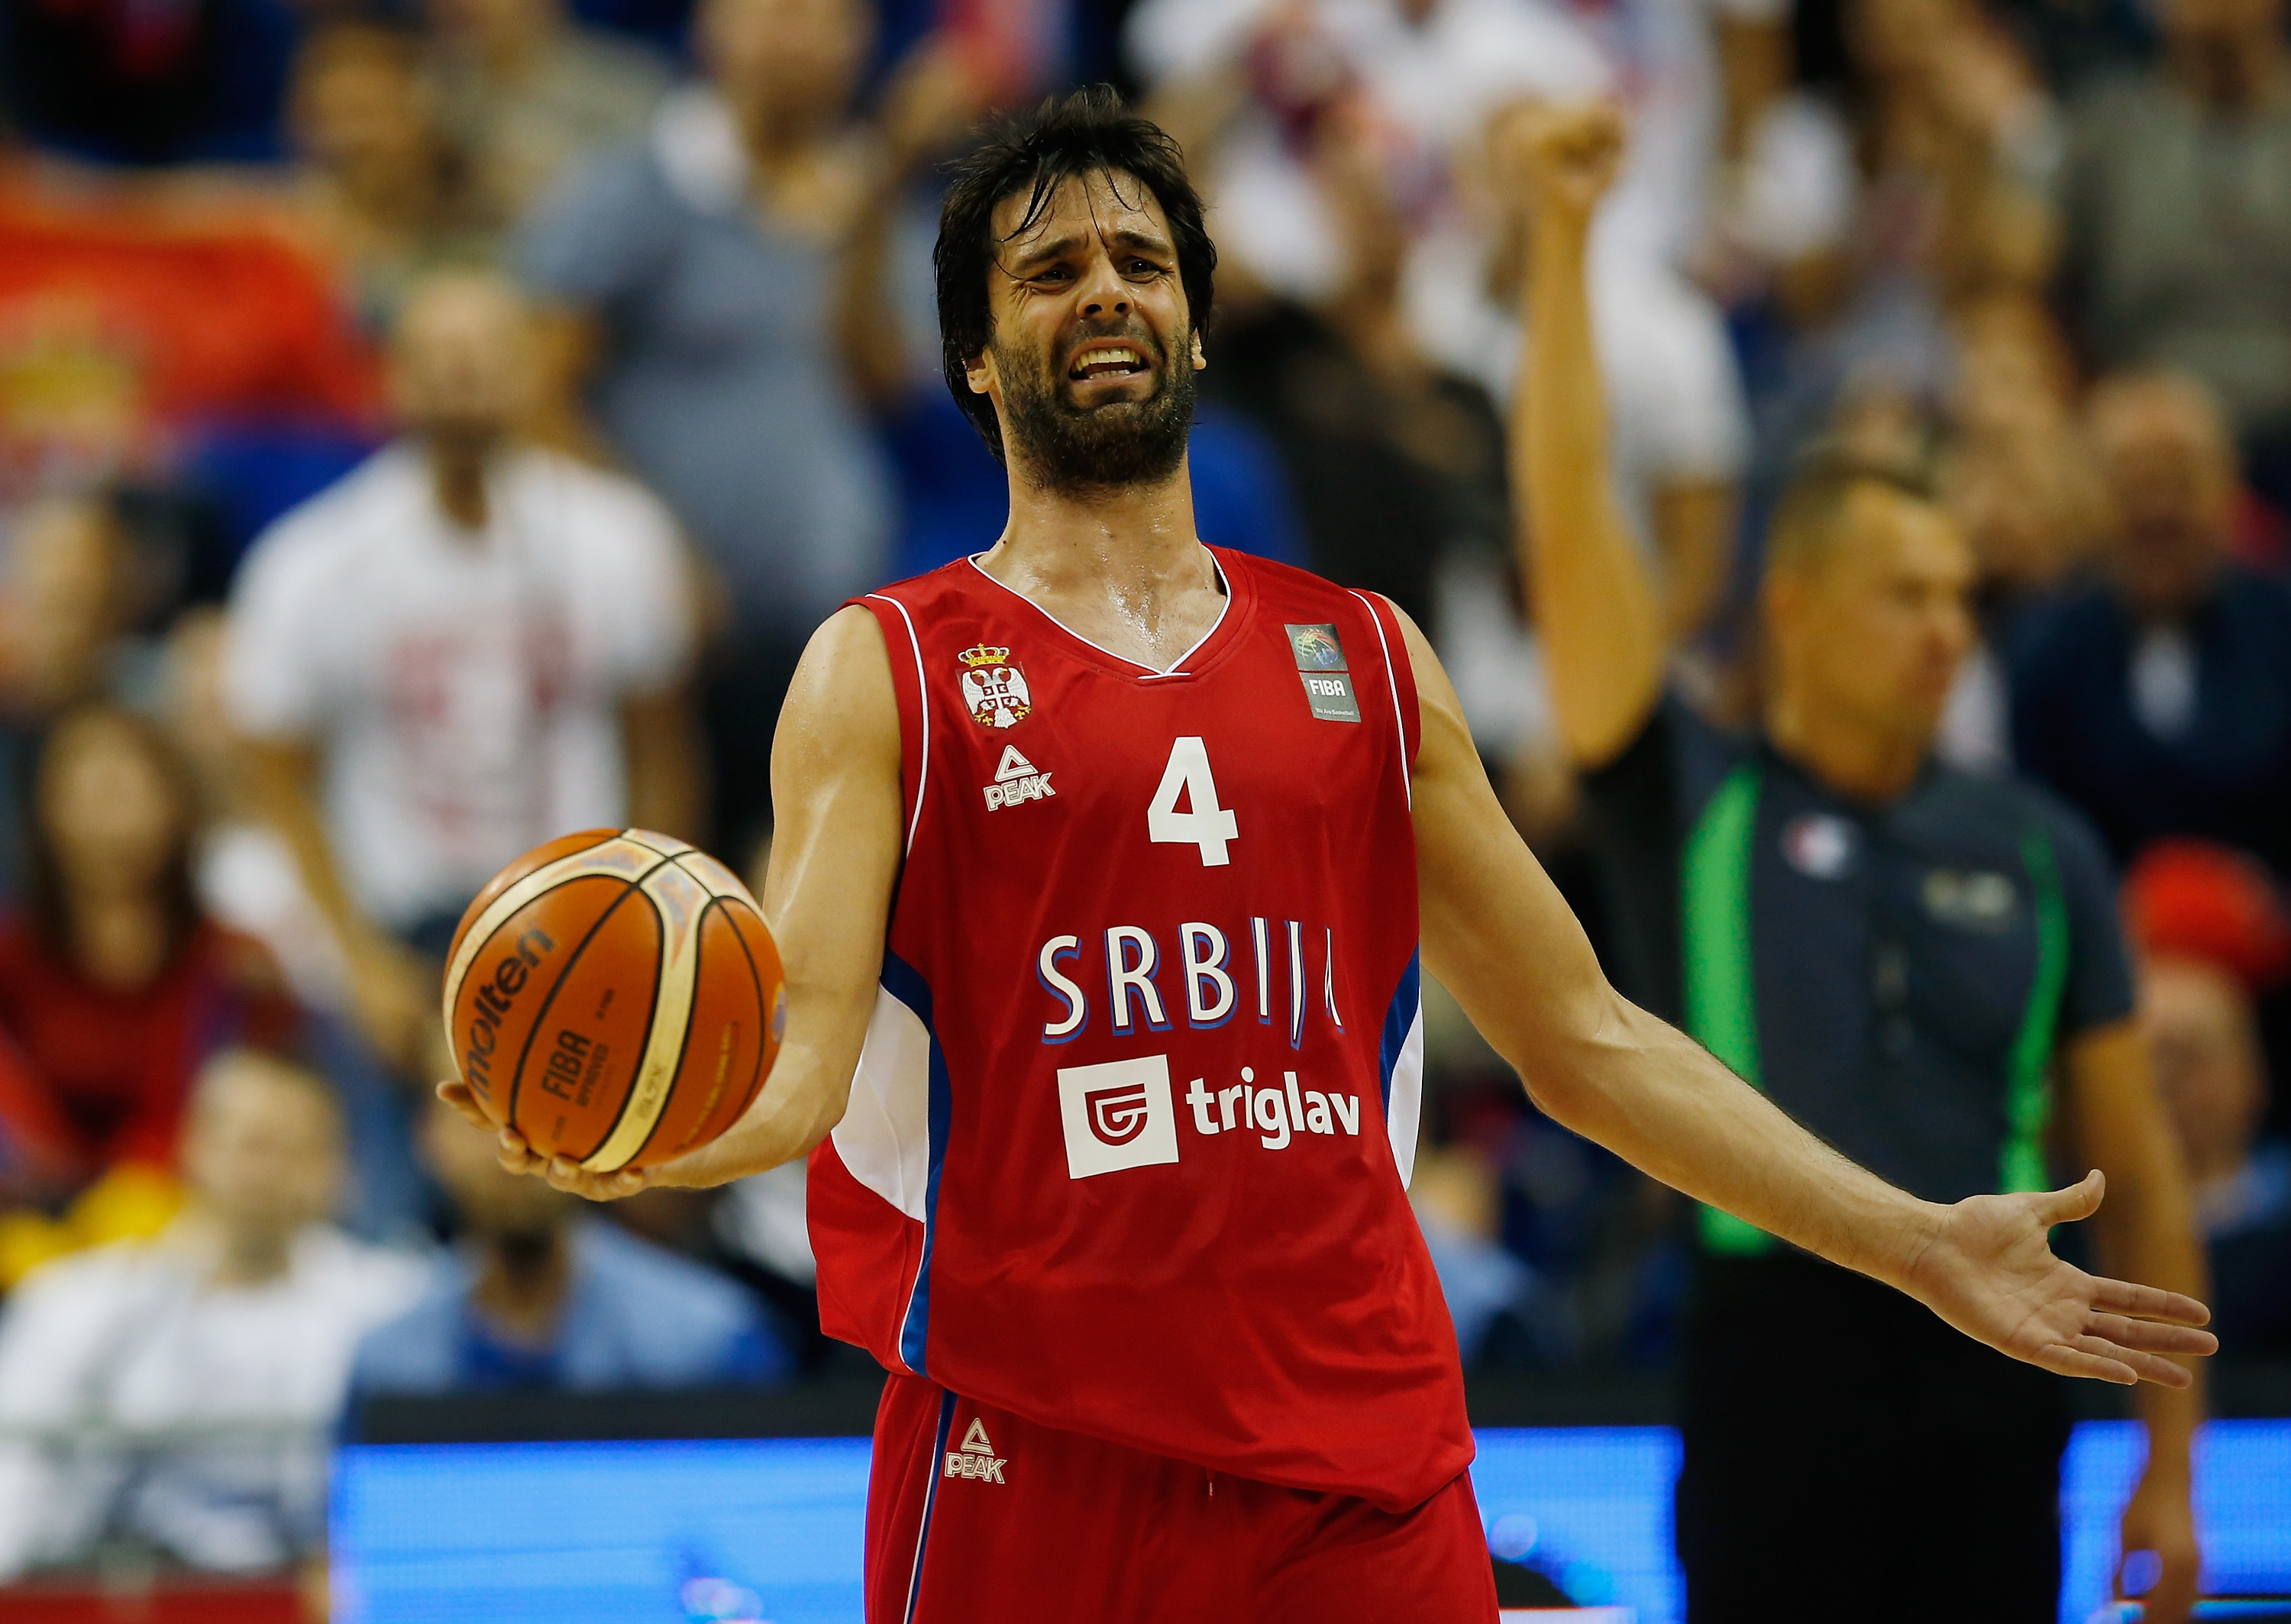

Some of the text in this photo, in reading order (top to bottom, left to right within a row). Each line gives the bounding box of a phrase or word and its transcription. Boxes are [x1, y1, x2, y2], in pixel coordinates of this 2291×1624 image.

[1309, 679, 1346, 696] FIBA
[983, 772, 1056, 812] PEAK
[1147, 736, 1239, 867] 4
[466, 927, 556, 1102] molten
[541, 1029, 591, 1100] FIBA
[1185, 1066, 1359, 1151] triglav
[945, 1452, 1007, 1484] PEAK
